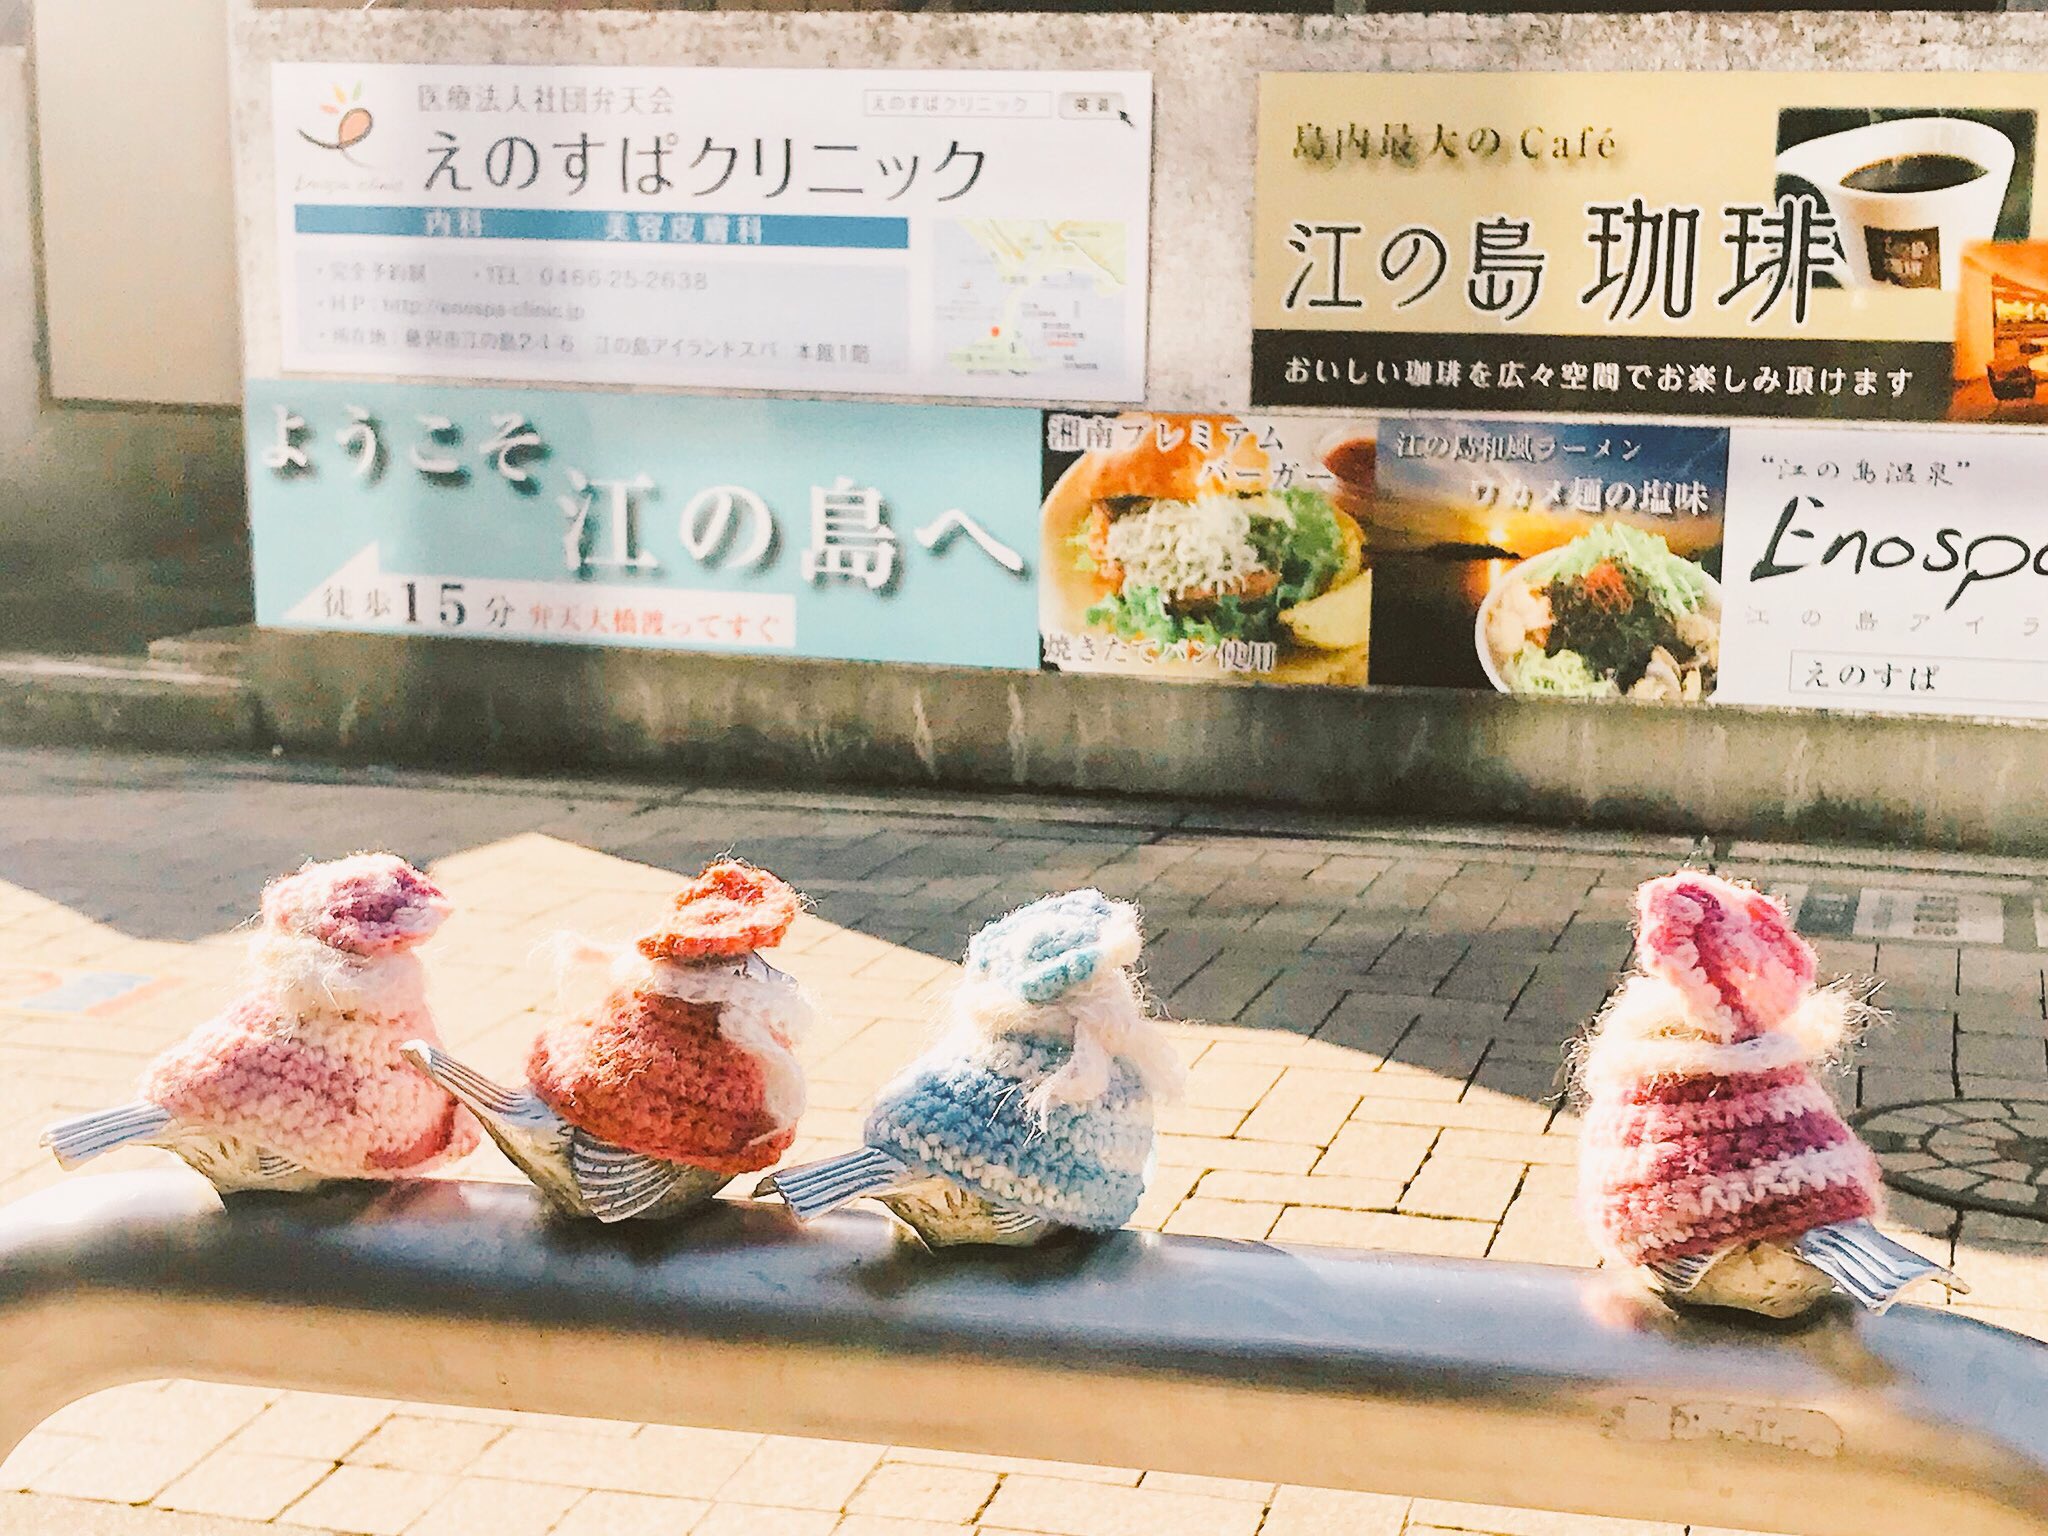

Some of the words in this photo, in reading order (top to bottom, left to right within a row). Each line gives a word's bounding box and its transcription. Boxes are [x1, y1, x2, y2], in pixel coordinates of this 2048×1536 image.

[416, 83, 674, 115] 医療法人社団弁天会
[1292, 122, 1502, 161] 島内最大の
[1519, 124, 1617, 160] Café
[424, 129, 985, 202] えのすぱクリニック
[424, 208, 483, 239] 内科
[1284, 215, 1546, 322] 江の島
[1580, 197, 1836, 324] 珈琲
[1283, 355, 1914, 398] おいしい珈琲を広々空間でお楽しみ頂けます
[262, 404, 545, 484] ようこそ
[1048, 416, 1284, 450] 湘南プレミアム
[1396, 431, 1642, 463] 江の島和風ラーメン
[1205, 458, 1333, 488] バーガー
[1471, 476, 1709, 516] ワカメ麺の塩味
[558, 466, 1025, 591] 江の島へ
[1804, 659, 1940, 692] えのすぱ
